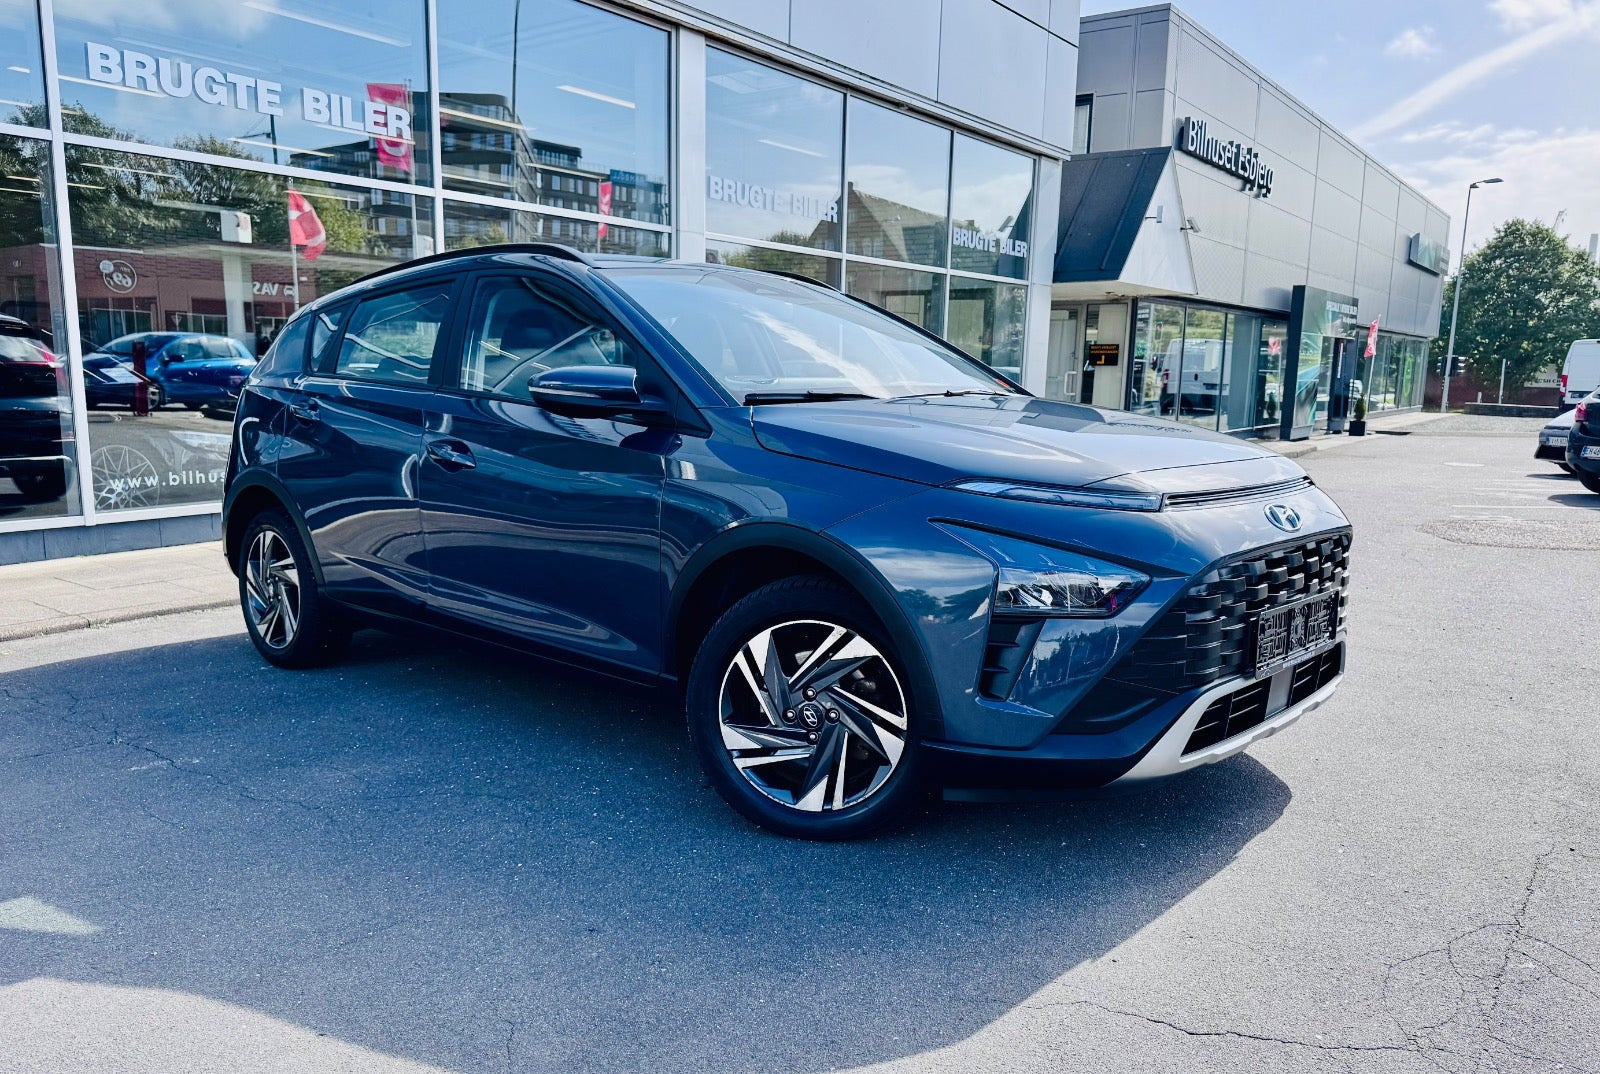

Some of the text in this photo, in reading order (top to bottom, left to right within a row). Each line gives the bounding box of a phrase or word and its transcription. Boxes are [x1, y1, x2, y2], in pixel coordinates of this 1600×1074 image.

[86, 41, 411, 140] BRUGTE BILER
[1186, 118, 1274, 198] Bilhuset Esbjerg
[708, 175, 838, 223] BRUGTE BILER
[953, 227, 1028, 258] BRUGTE BILER
